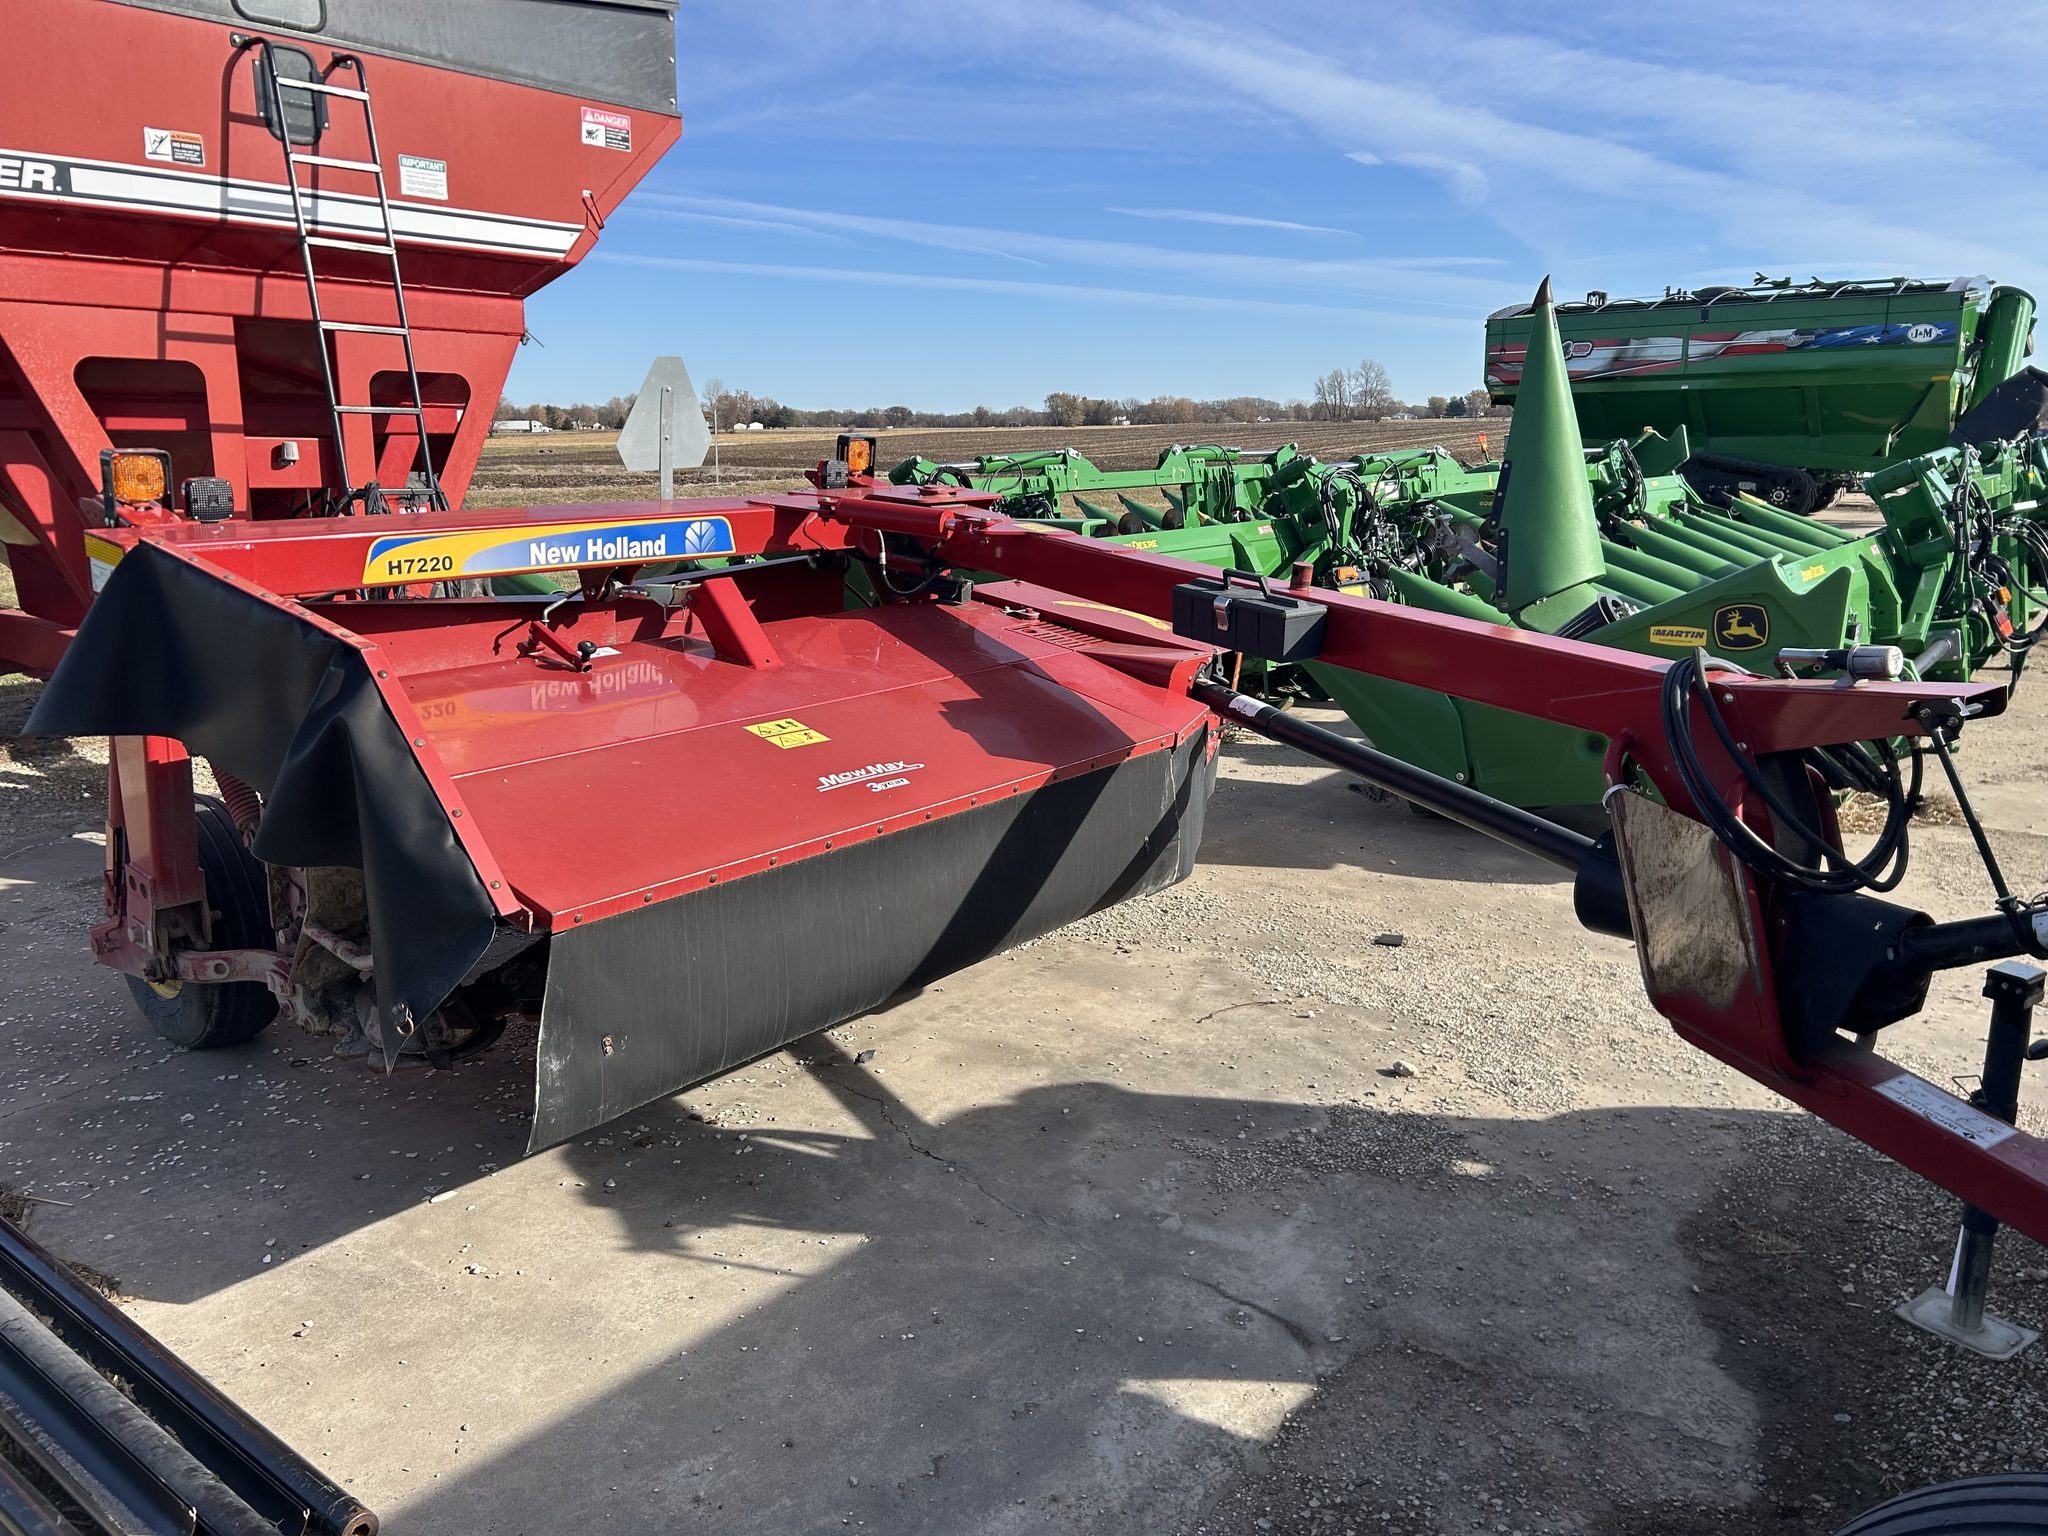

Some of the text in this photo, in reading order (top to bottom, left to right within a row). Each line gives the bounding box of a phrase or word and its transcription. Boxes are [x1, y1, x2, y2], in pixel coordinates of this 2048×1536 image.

[593, 112, 628, 127] DANGER
[176, 133, 201, 142] WARNING
[401, 157, 444, 171] IMPORTANT
[1911, 328, 1933, 338] J&M
[529, 534, 666, 566] New Holland
[1131, 540, 1158, 550] DEERE
[387, 556, 453, 575] H7220
[1654, 629, 1705, 639] MARTIN
[1895, 1096, 1958, 1130] IMPORTANT
